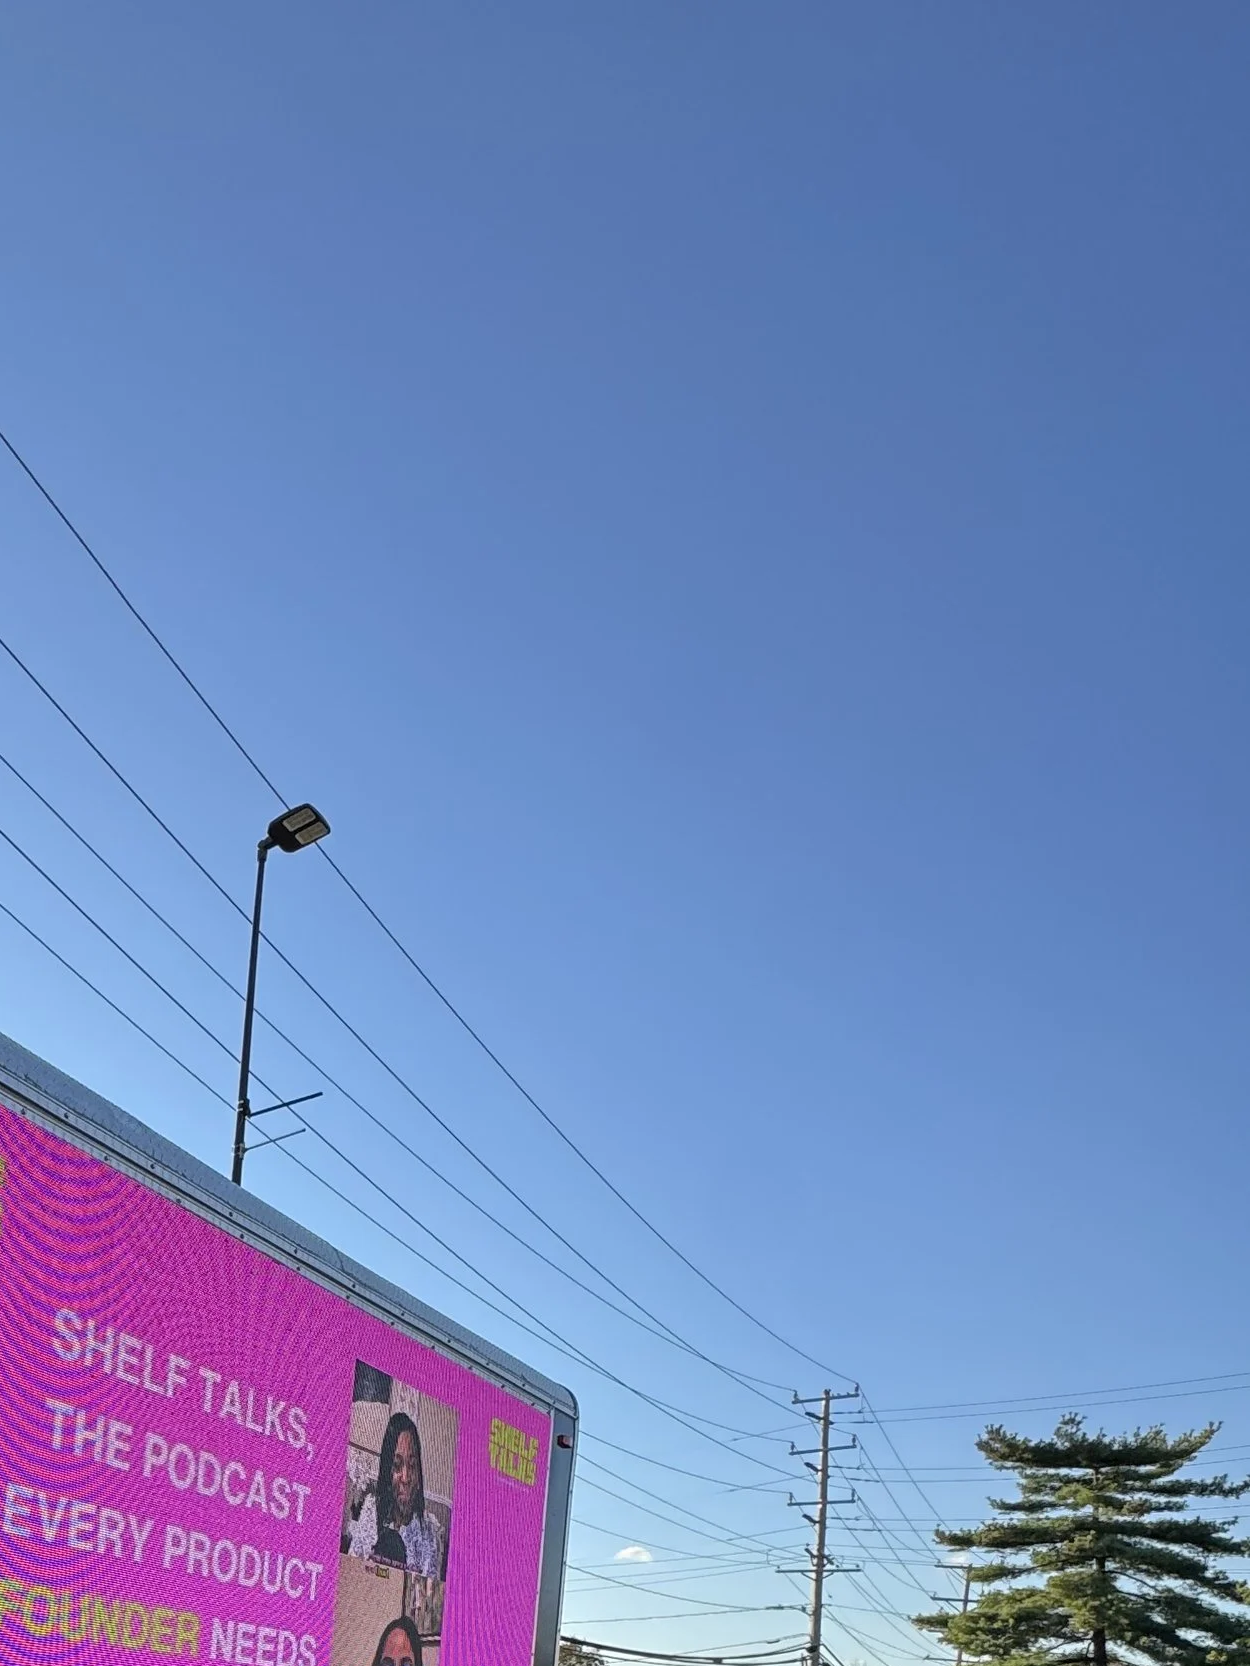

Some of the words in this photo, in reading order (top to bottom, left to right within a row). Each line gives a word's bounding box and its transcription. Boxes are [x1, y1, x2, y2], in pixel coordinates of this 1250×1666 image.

[54, 1308, 191, 1398] SHELF
[199, 1366, 315, 1462] TALKS,
[46, 1399, 133, 1472] THE
[143, 1433, 310, 1524] PODCAST
[3, 1482, 151, 1562] EVERY
[162, 1524, 324, 1601] PRODUCT
